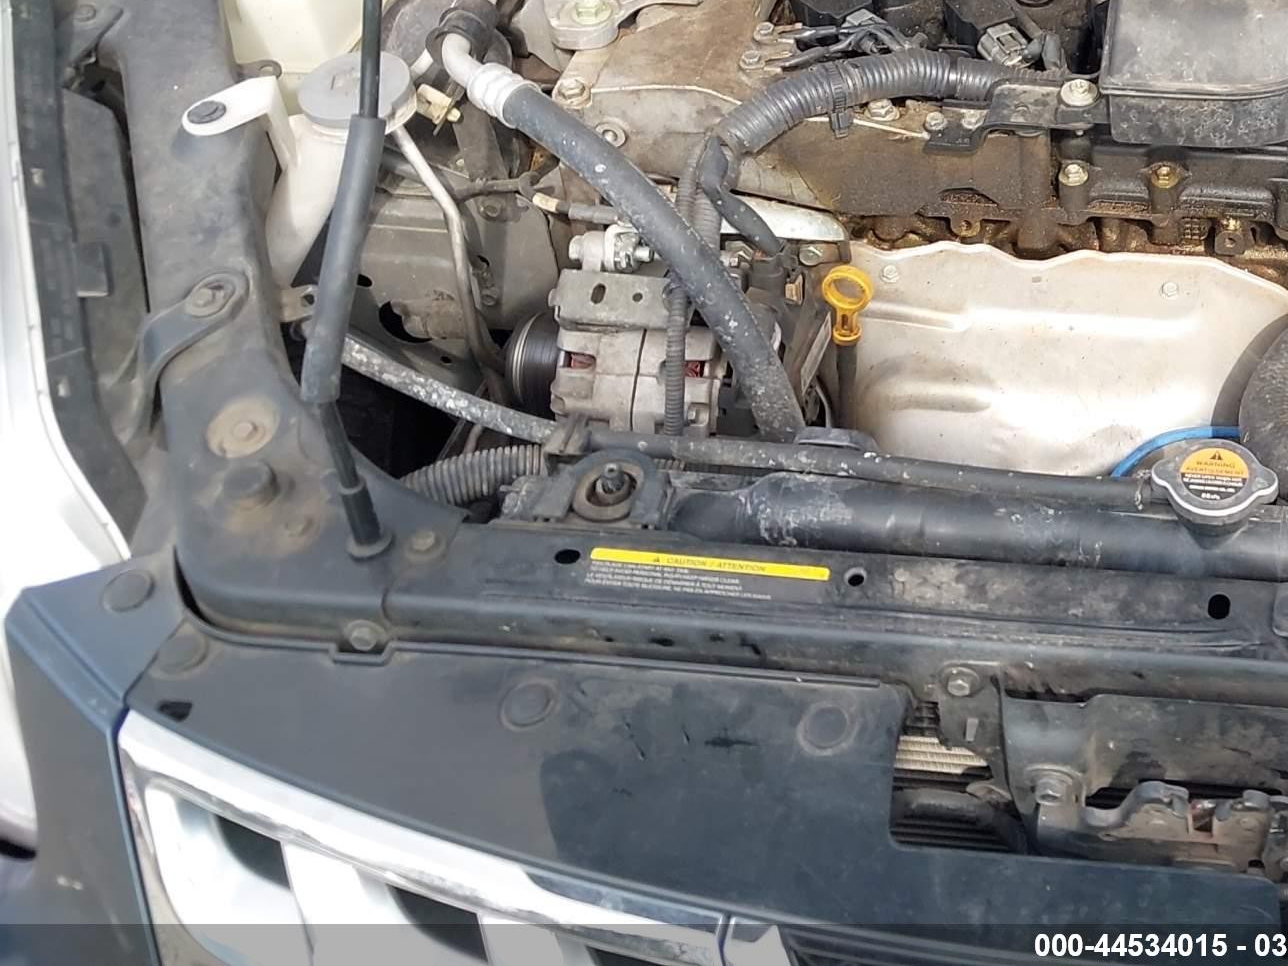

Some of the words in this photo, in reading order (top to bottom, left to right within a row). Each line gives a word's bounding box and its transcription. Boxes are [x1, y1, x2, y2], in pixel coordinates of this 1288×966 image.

[1196, 461, 1236, 469] WARNING
[667, 557, 706, 567] CAUTION
[717, 561, 766, 572] ATTENTION
